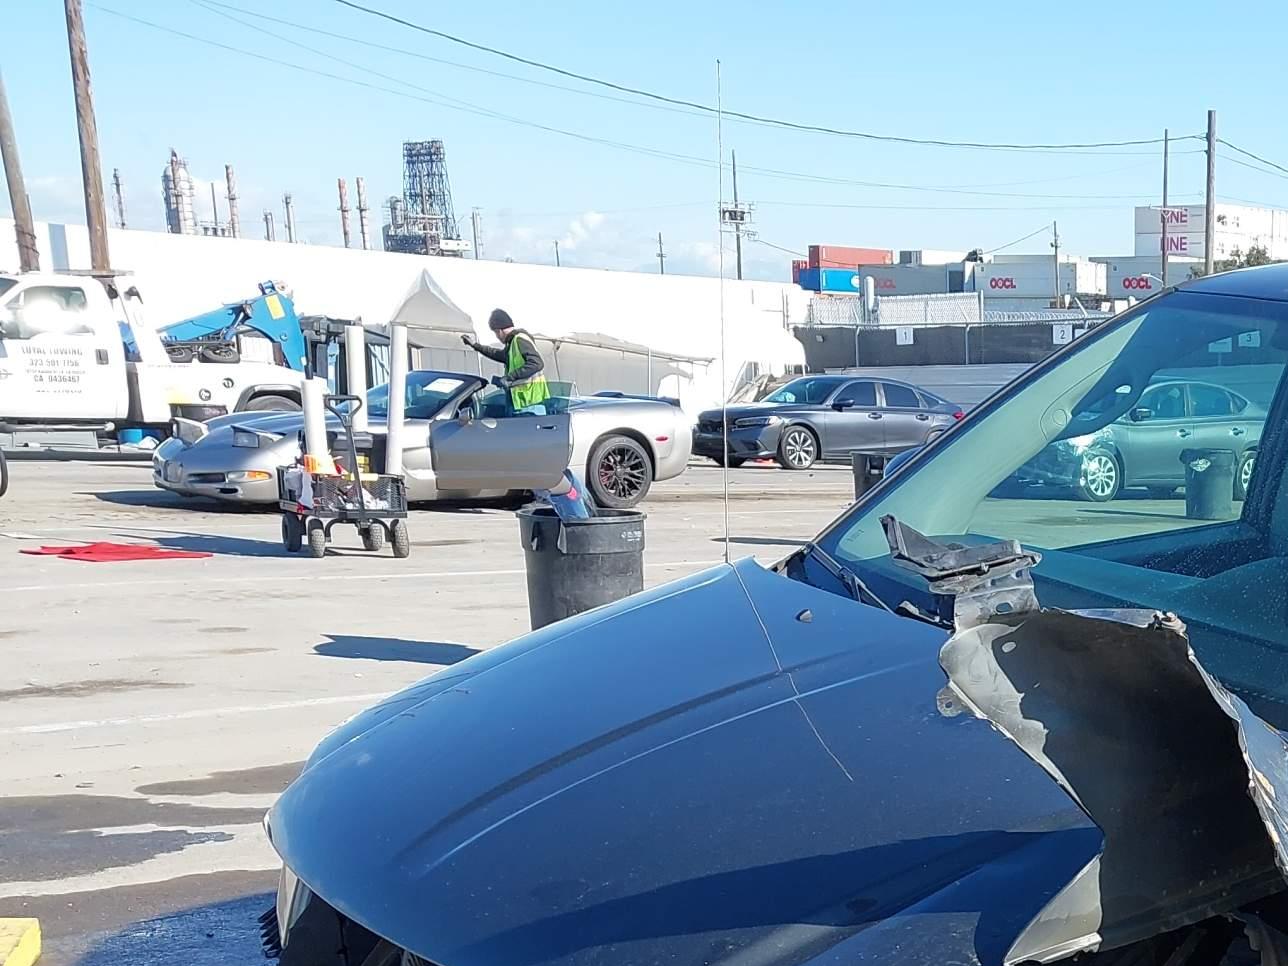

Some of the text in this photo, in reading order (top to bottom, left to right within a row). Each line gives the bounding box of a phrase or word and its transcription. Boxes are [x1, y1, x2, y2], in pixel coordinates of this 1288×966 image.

[990, 278, 1016, 289] OOCL
[1123, 278, 1152, 289] OOCL
[1060, 330, 1066, 340] 2
[1246, 334, 1252, 343] 3
[34, 375, 43, 383] CA
